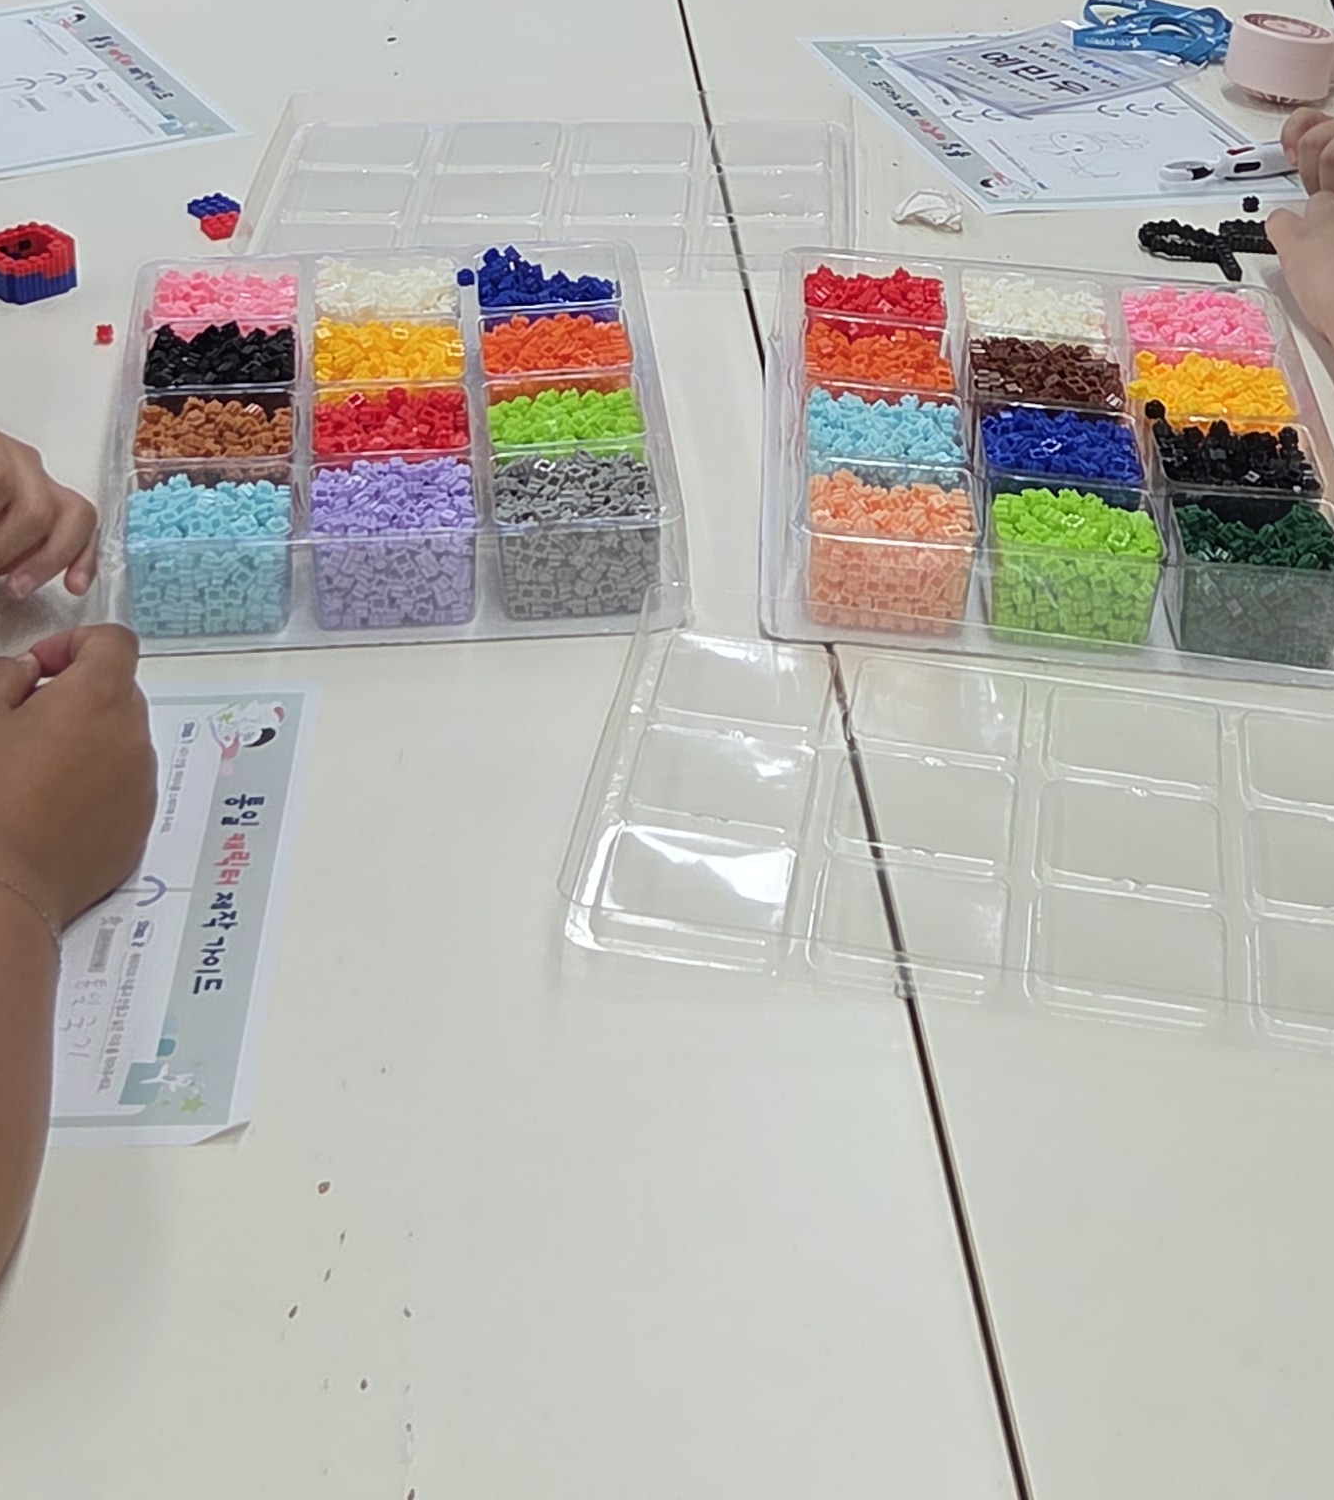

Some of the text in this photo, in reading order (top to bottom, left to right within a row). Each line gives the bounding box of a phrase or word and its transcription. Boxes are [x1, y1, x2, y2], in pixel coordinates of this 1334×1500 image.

[980, 51, 1091, 96] 예민우
[192, 793, 265, 995] 통일 캐릭터 제작 가이드
